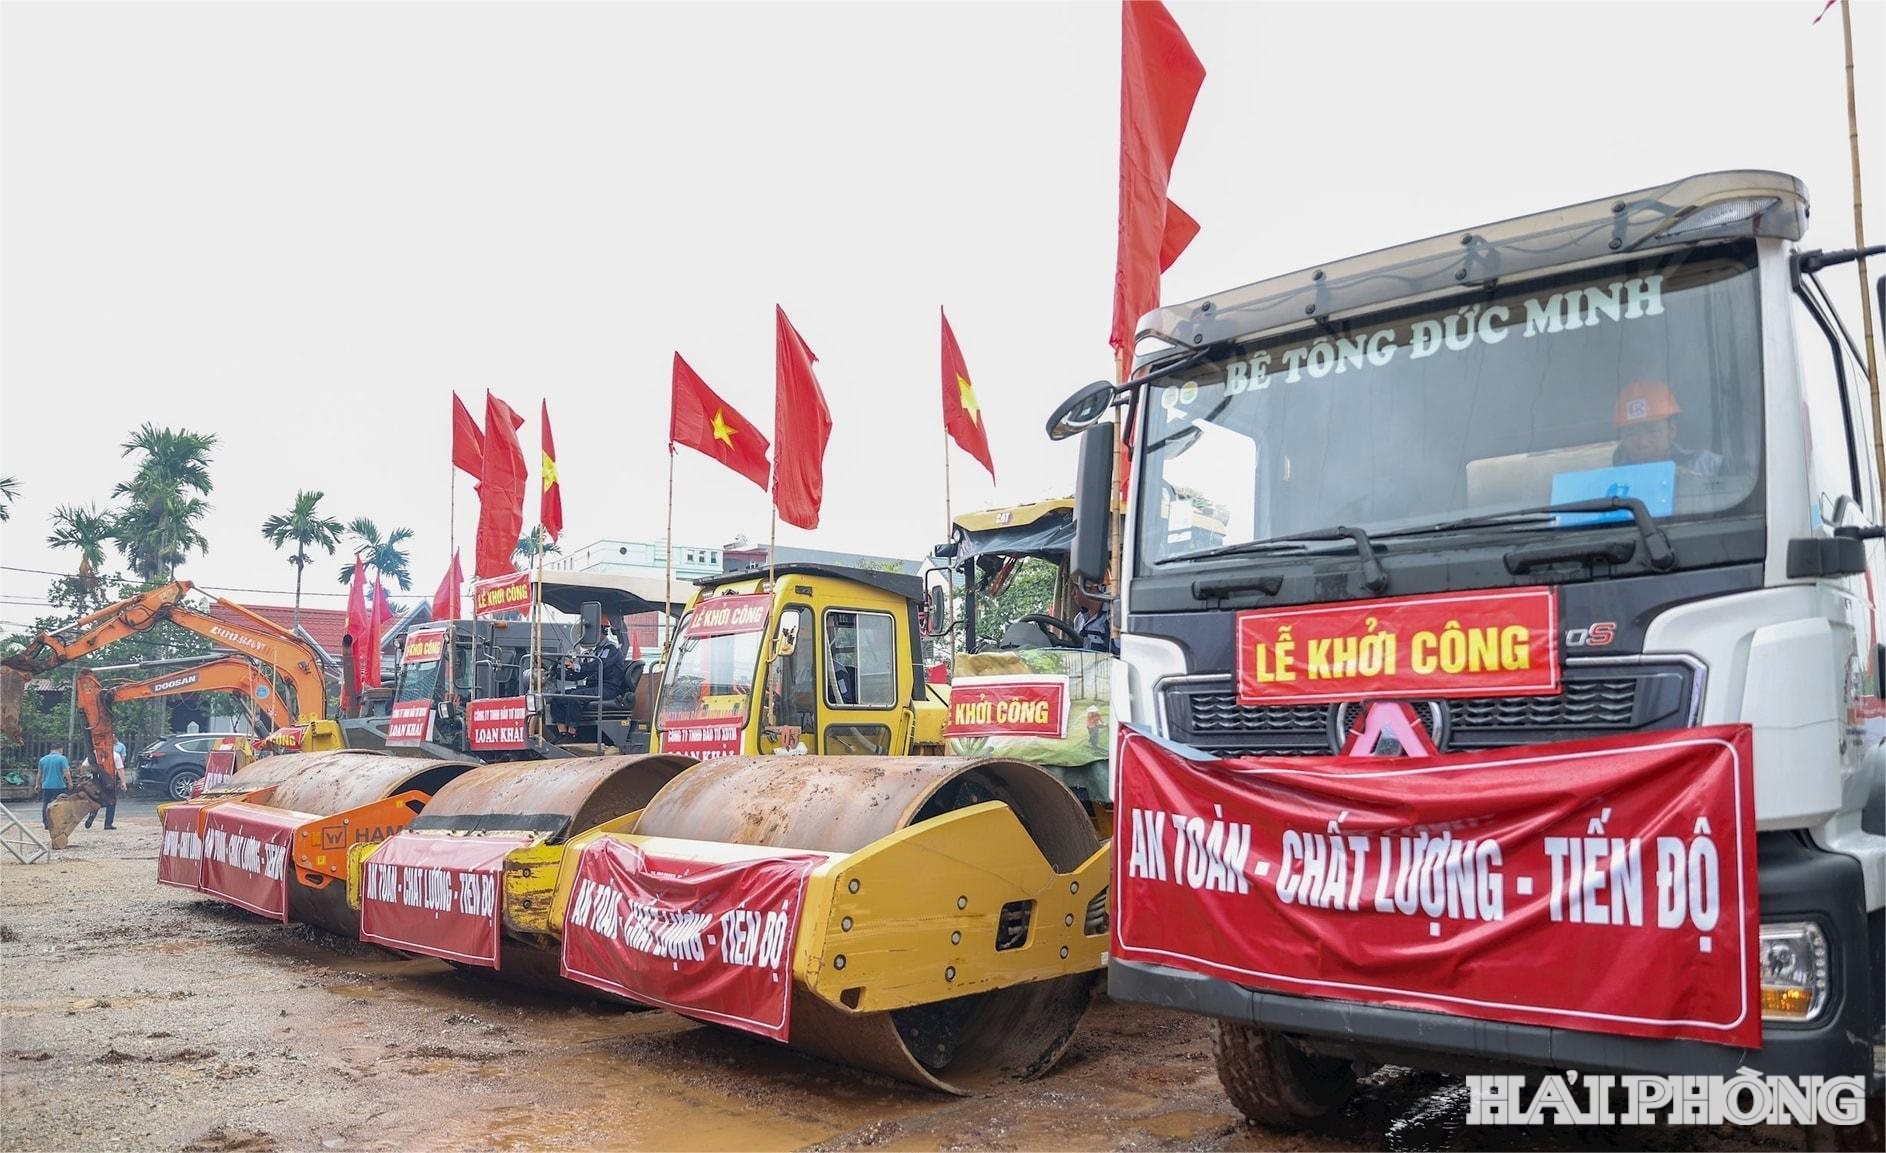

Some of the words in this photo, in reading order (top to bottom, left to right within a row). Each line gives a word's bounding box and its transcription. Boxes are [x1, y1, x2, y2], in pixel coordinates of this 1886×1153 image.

[1224, 351, 1271, 397] BÊ
[1282, 329, 1398, 384] TÔNG
[1409, 303, 1510, 360] ĐỨC
[1523, 275, 1665, 338] MINH
[505, 583, 528, 602] CÔNG
[703, 602, 730, 627] KHỞI
[731, 604, 765, 624] CÔNG
[1256, 625, 1296, 683] LỄ
[1308, 617, 1397, 679] KHỞI
[1411, 620, 1531, 675] CÔNG
[154, 675, 196, 692] DOOSAN
[955, 693, 992, 725] KHỞI
[996, 697, 1048, 725] CÔNG
[475, 728, 499, 743] LOAN
[500, 720, 524, 743] KHẢI
[1129, 808, 1167, 881] AN
[1171, 804, 1251, 895] TOÀN
[1254, 861, 1270, 876] -
[1275, 811, 1370, 911] CHẤT
[1375, 830, 1504, 937] LƯỢNG
[1517, 876, 1533, 895] -
[1544, 808, 1644, 927] TIẾN
[1656, 816, 1721, 953] ĐỘ
[571, 879, 597, 928] AN
[707, 934, 716, 945] -
[721, 901, 762, 966] TIẾN
[758, 899, 788, 982] ĐỘ
